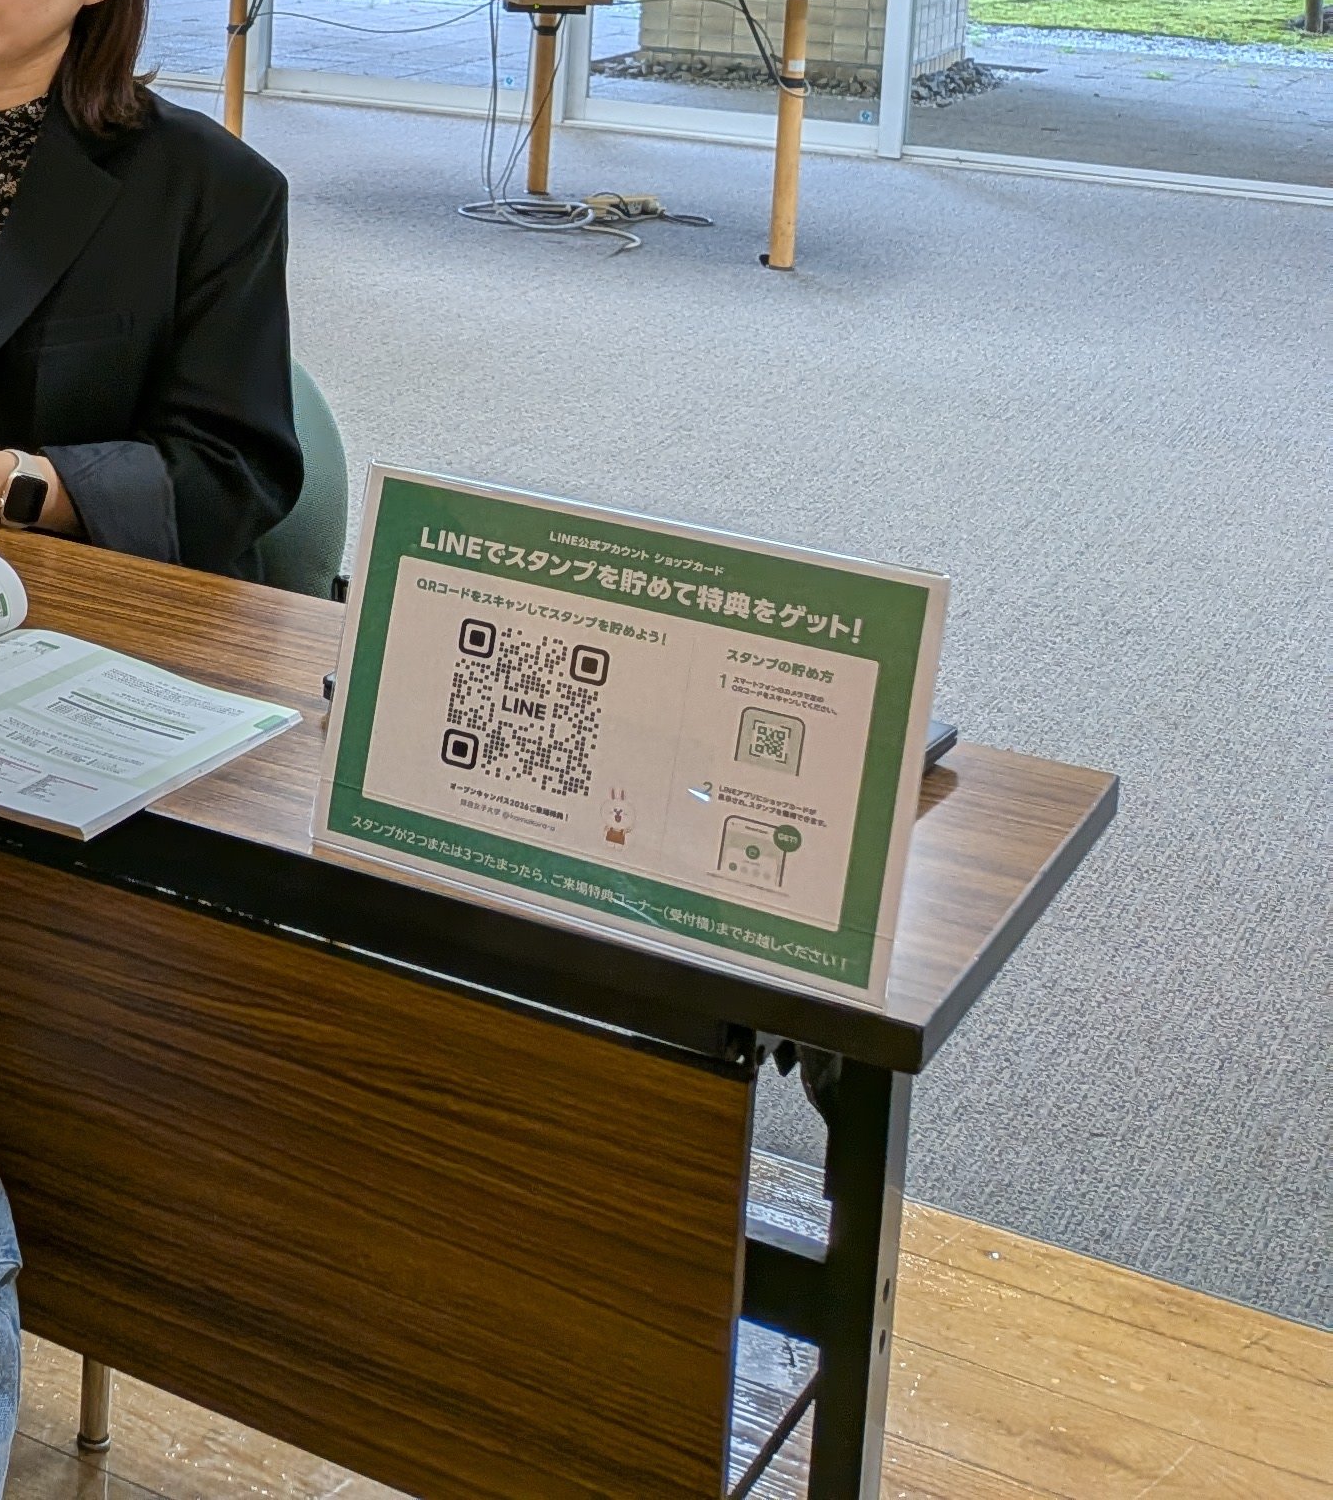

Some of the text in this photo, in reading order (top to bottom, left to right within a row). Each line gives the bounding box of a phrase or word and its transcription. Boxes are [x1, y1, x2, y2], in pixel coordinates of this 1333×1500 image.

[549, 530, 724, 576] LINE公式アカウント ショップカード
[420, 526, 862, 643] LINEでスタンプを貯めて特典をゲット!
[417, 578, 667, 646] QRコードをスキャンしてスタンプを貯めよう!
[727, 649, 834, 683] スタンプの貯め方
[501, 695, 547, 721] LINE
